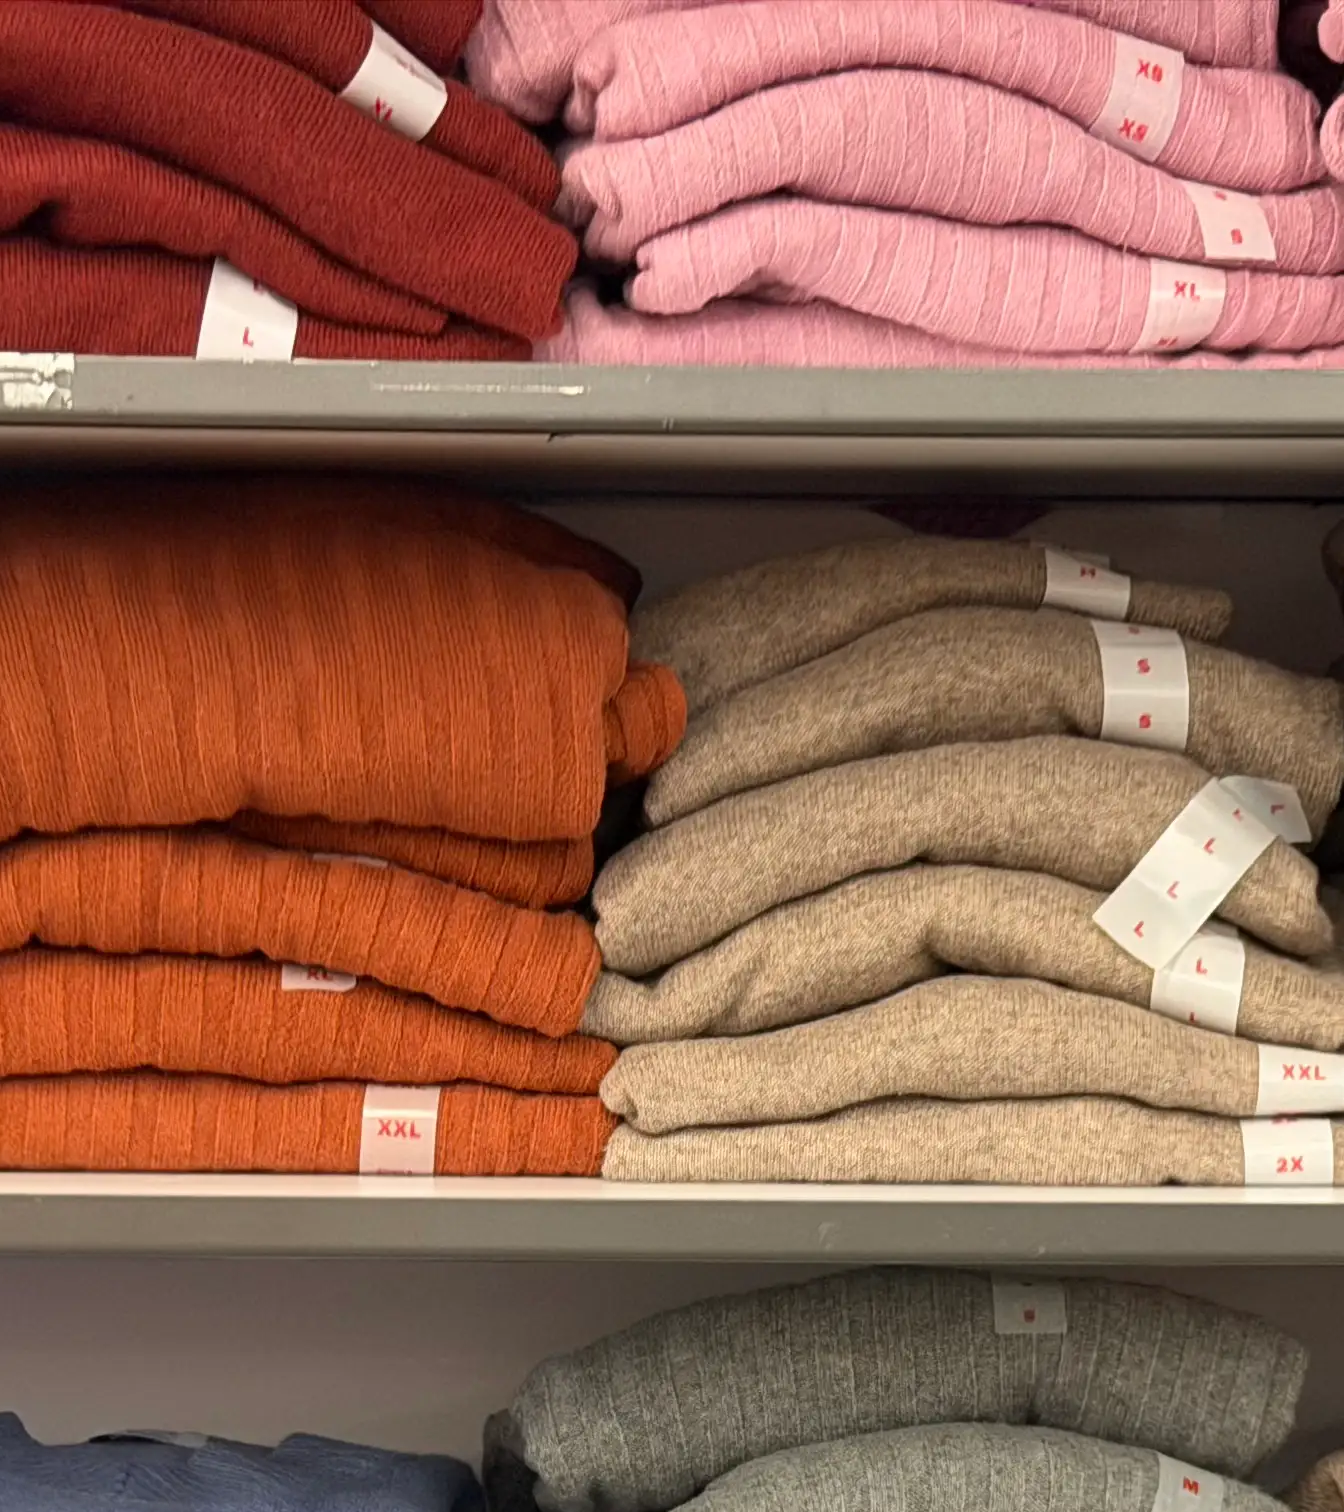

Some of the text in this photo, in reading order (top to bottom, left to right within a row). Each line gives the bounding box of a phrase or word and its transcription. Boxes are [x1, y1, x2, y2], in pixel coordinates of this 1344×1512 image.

[1136, 59, 1163, 83] XS
[1119, 118, 1148, 143] XS
[1174, 280, 1200, 302] XL
[242, 326, 254, 347] L
[1203, 837, 1216, 856] L
[1166, 881, 1179, 899] L
[1134, 920, 1145, 938] L
[1195, 956, 1208, 975] L
[1281, 1063, 1324, 1082] XXL
[377, 1119, 422, 1140] XXL
[1275, 1156, 1304, 1174] 2X
[1182, 1476, 1200, 1496] M
